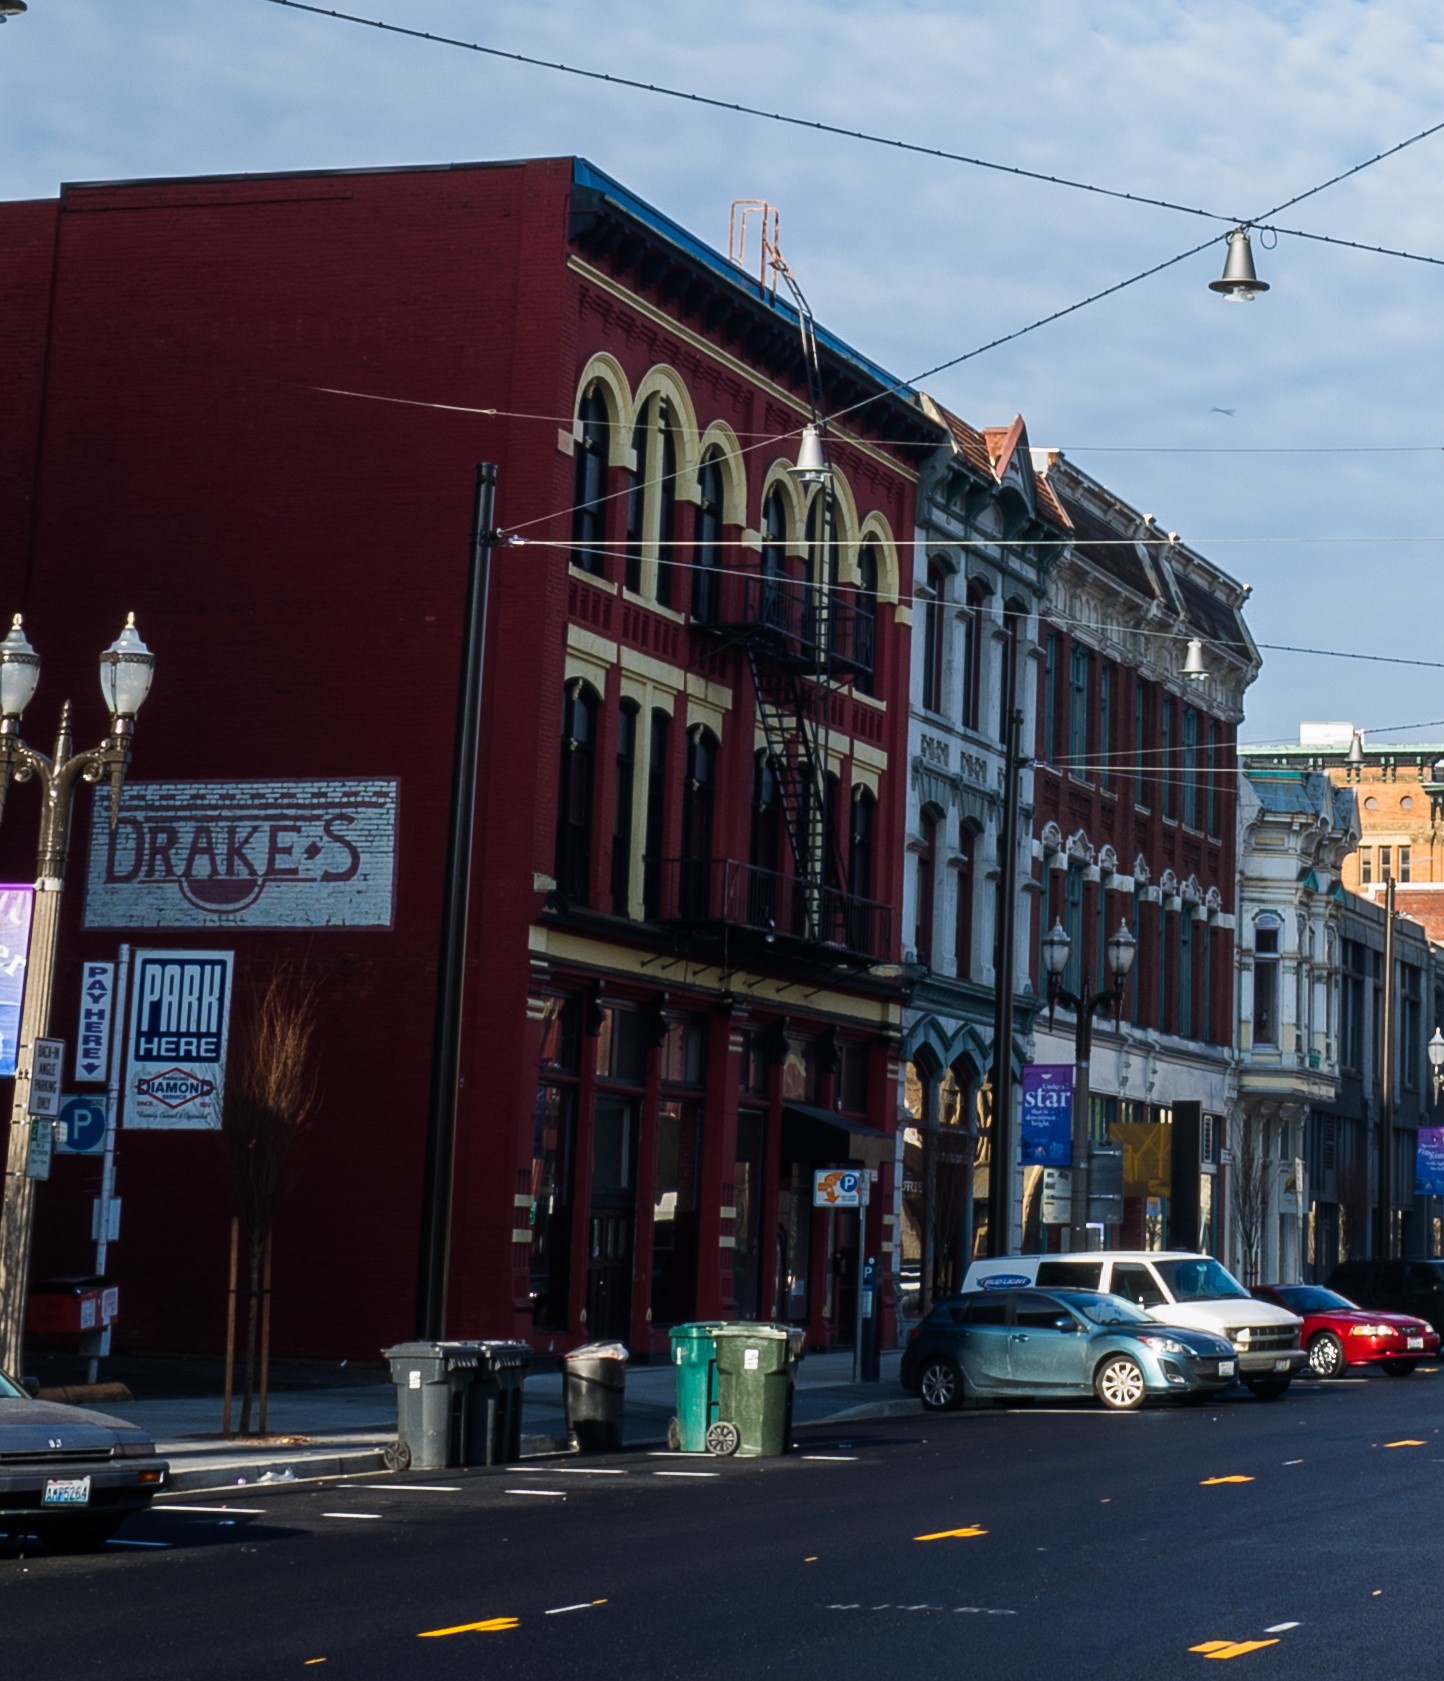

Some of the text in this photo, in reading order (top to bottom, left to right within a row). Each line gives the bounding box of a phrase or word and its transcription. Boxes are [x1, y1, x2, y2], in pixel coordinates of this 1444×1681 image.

[141, 964, 222, 1033] PARK
[81, 966, 109, 1060] PAY HERE
[139, 1036, 218, 1057] HERE
[137, 1078, 214, 1097] DIAMOND
[1024, 1088, 1071, 1108] star
[73, 1109, 92, 1139] P
[844, 1176, 855, 1190] P
[864, 1266, 873, 1279] P
